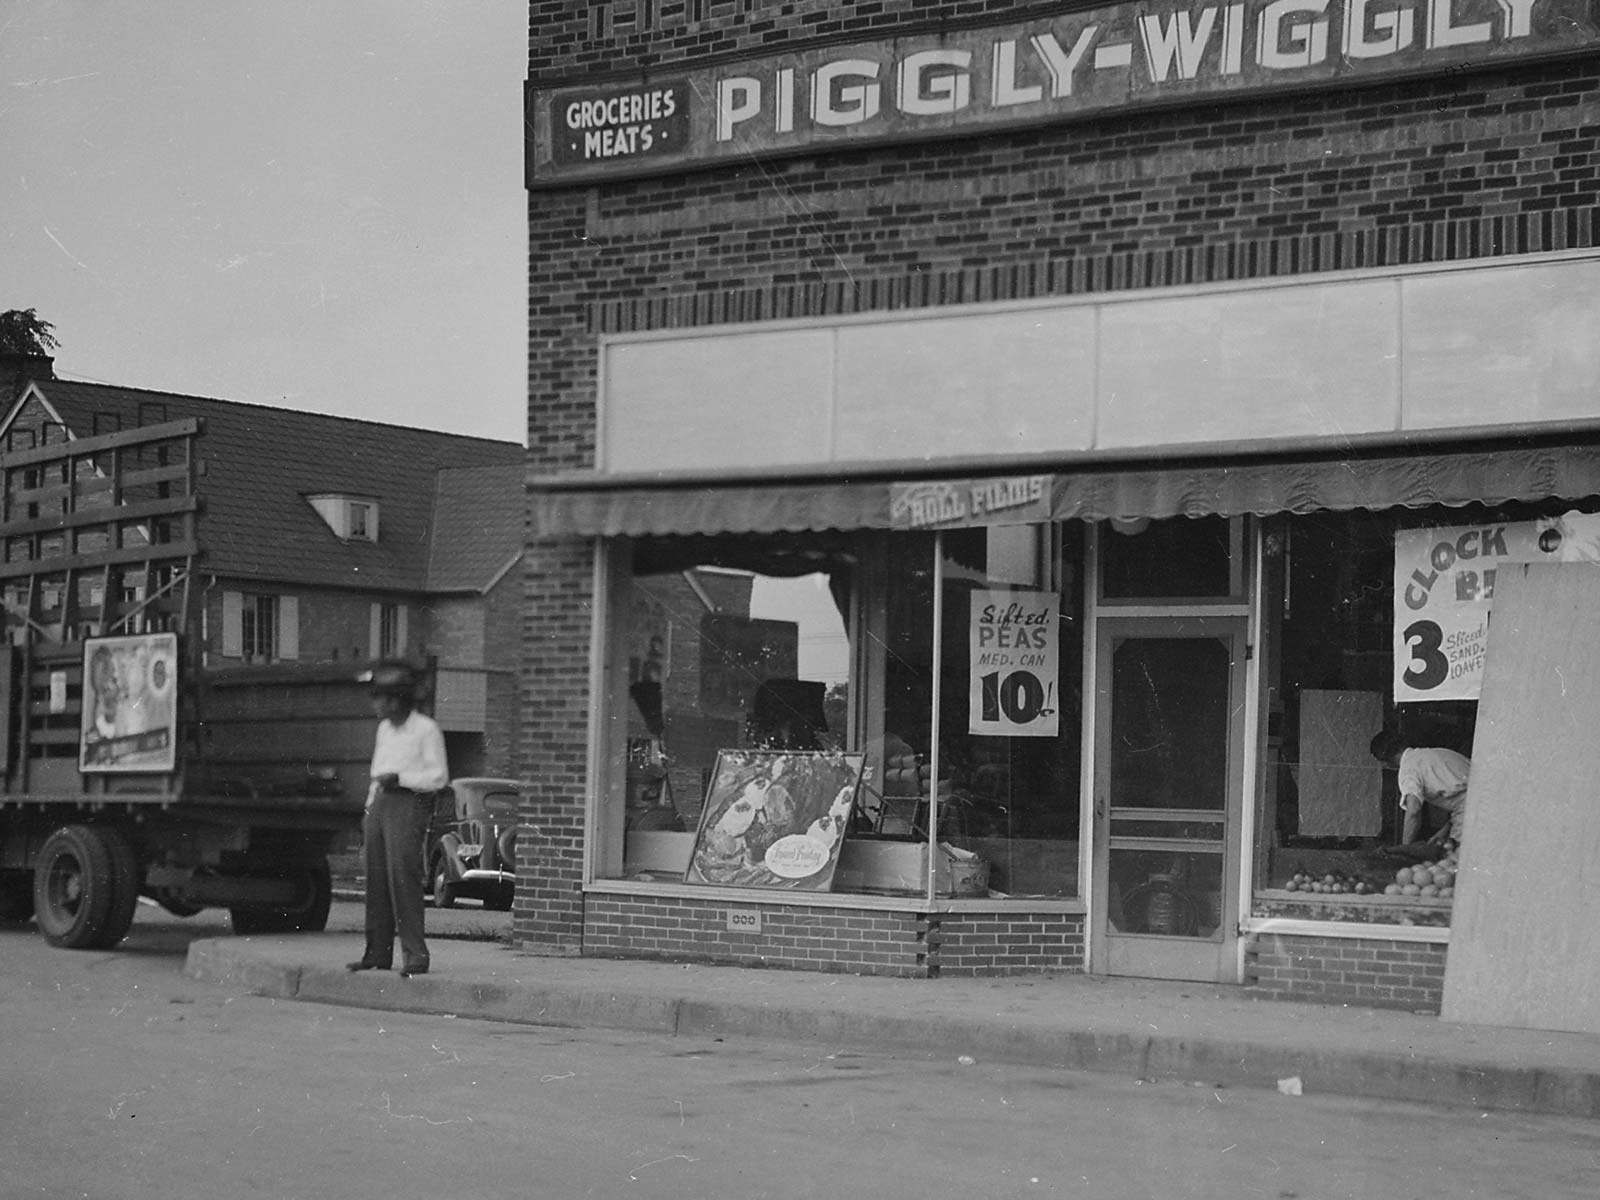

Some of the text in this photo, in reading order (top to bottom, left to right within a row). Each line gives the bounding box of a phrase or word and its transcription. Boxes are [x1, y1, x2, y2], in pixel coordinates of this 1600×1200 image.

[566, 88, 676, 129] GROCERIES
[911, 477, 1042, 526] ROLL FILMS
[1404, 527, 1509, 611] CLOCK
[978, 653, 1047, 667] MED. CAN
[979, 626, 1048, 650] PEAS
[1402, 619, 1449, 690] 3
